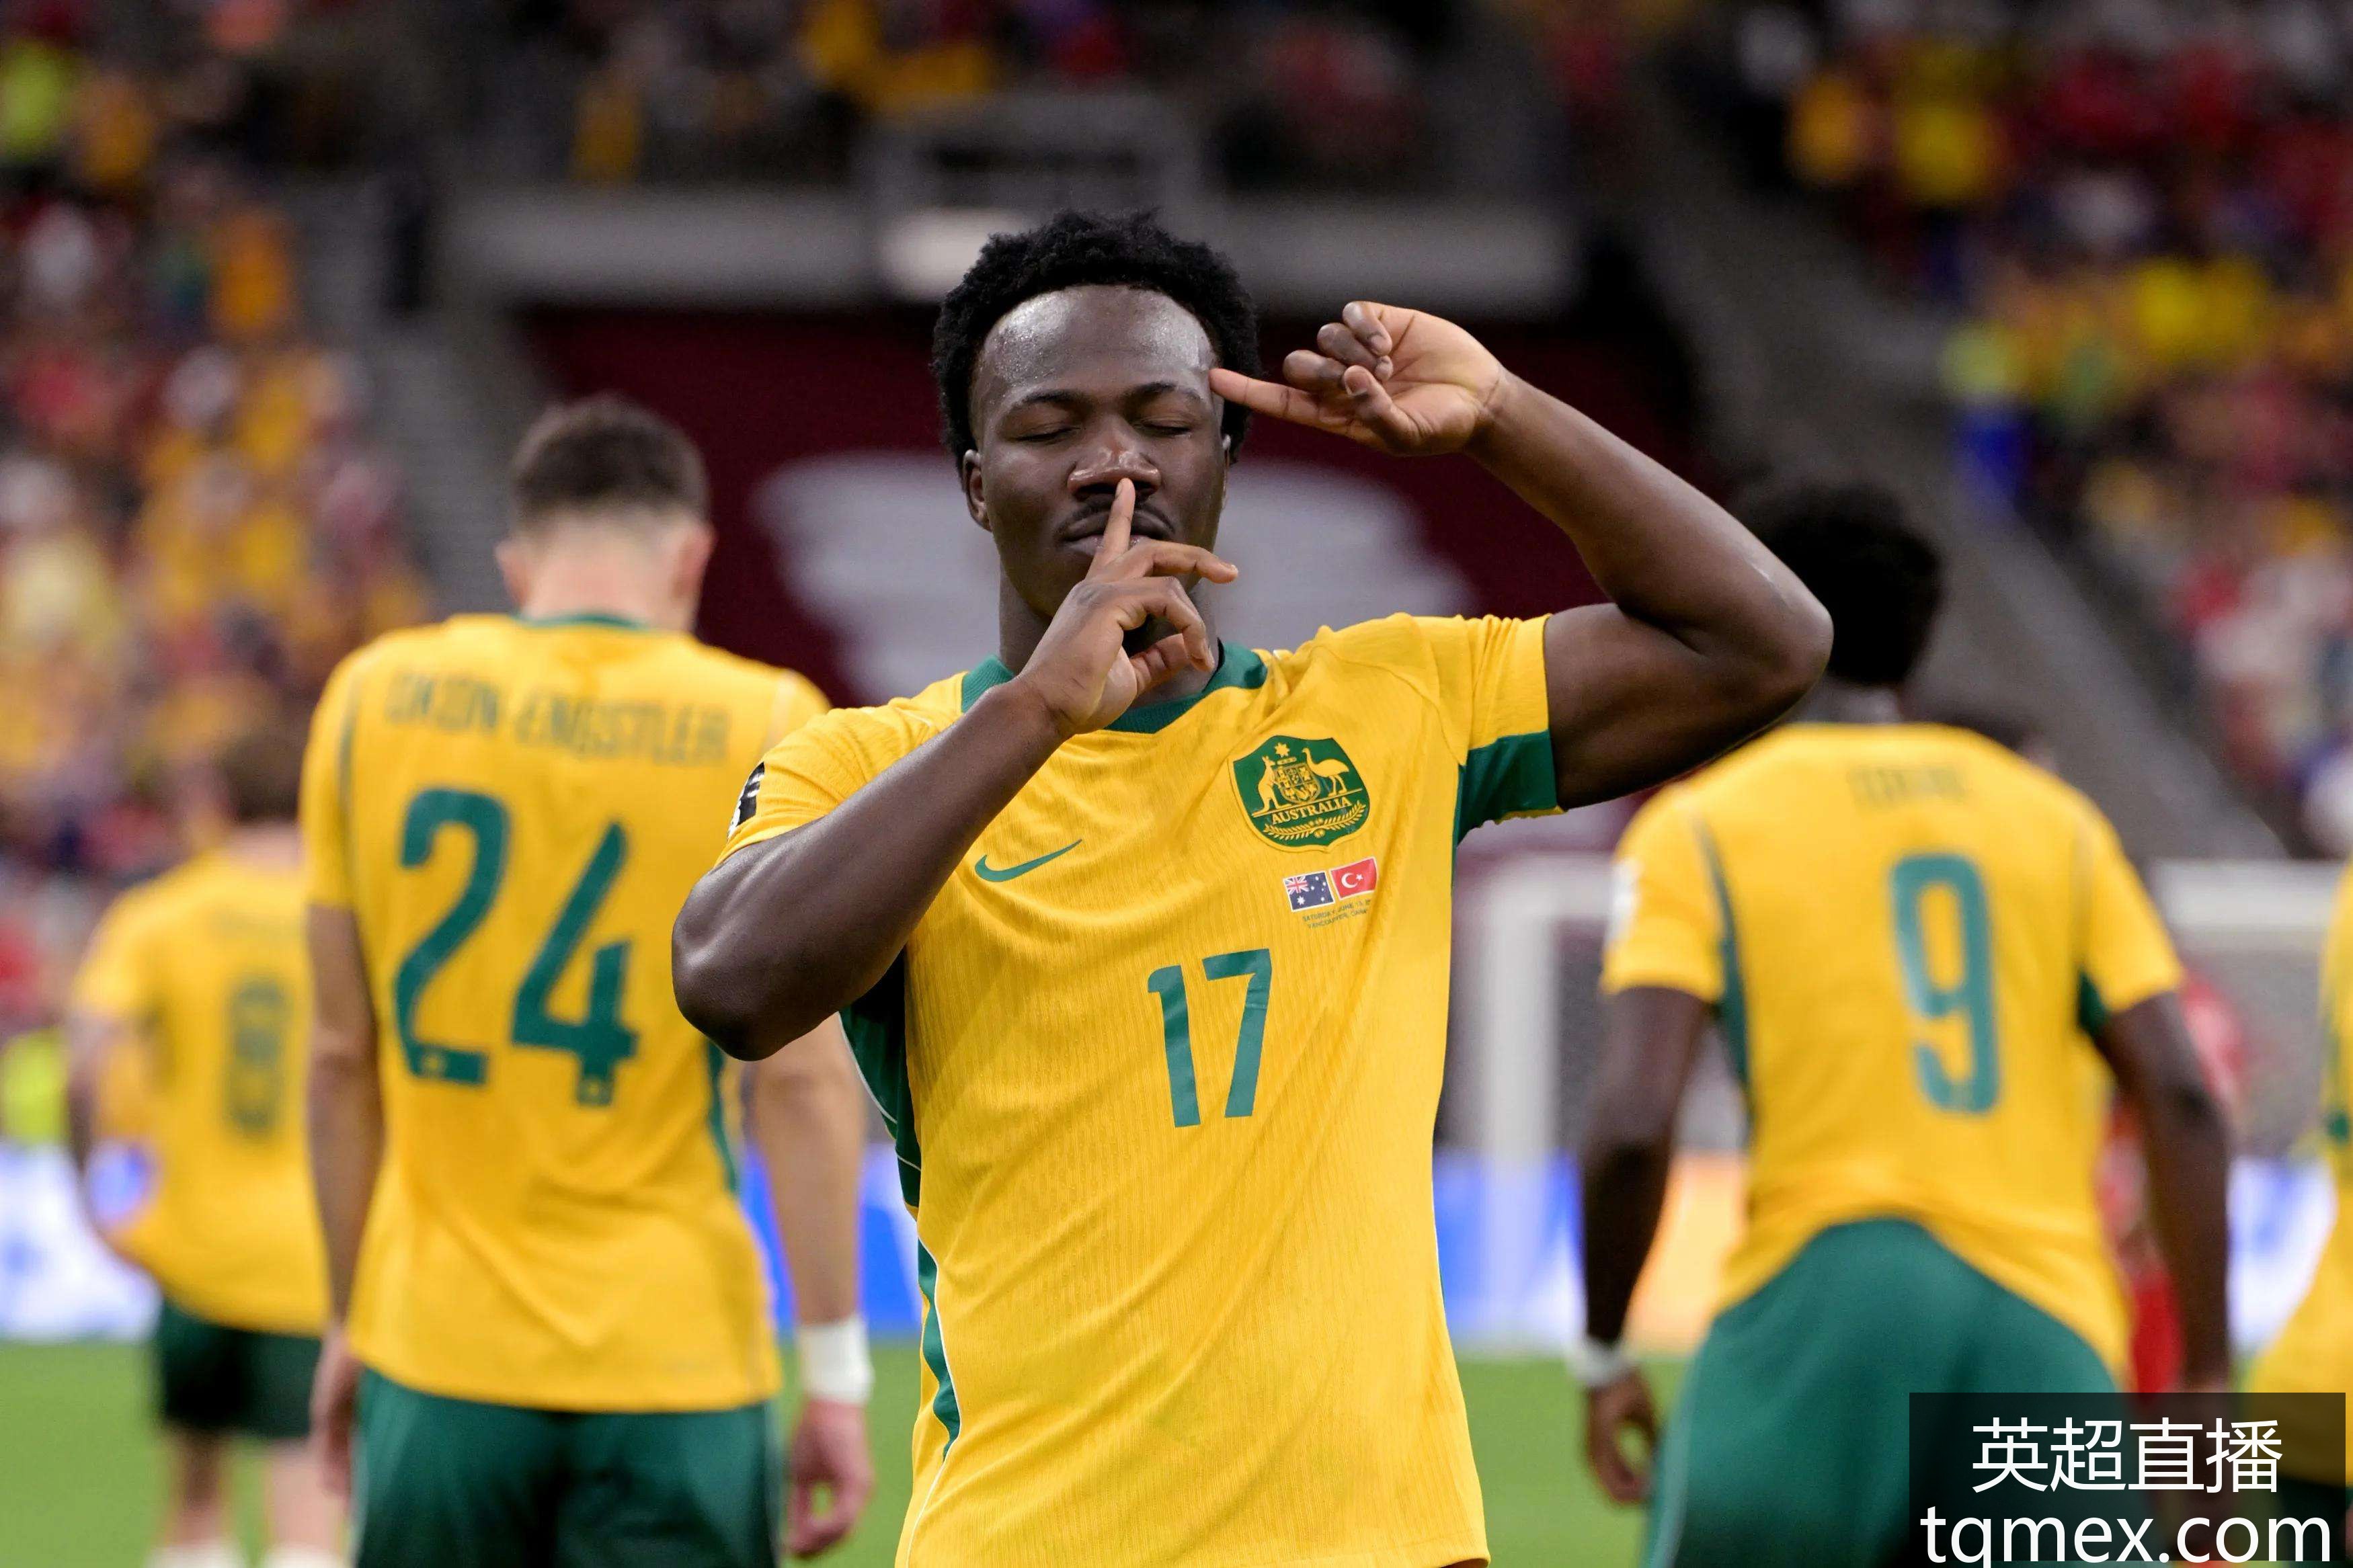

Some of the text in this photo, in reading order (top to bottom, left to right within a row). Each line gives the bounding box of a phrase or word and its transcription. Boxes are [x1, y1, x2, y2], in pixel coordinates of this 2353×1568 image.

[1272, 796, 1352, 825] AUSTRALIA
[394, 786, 643, 1106] 24
[1148, 948, 1272, 1128] 17
[1889, 852, 2001, 1116] 9
